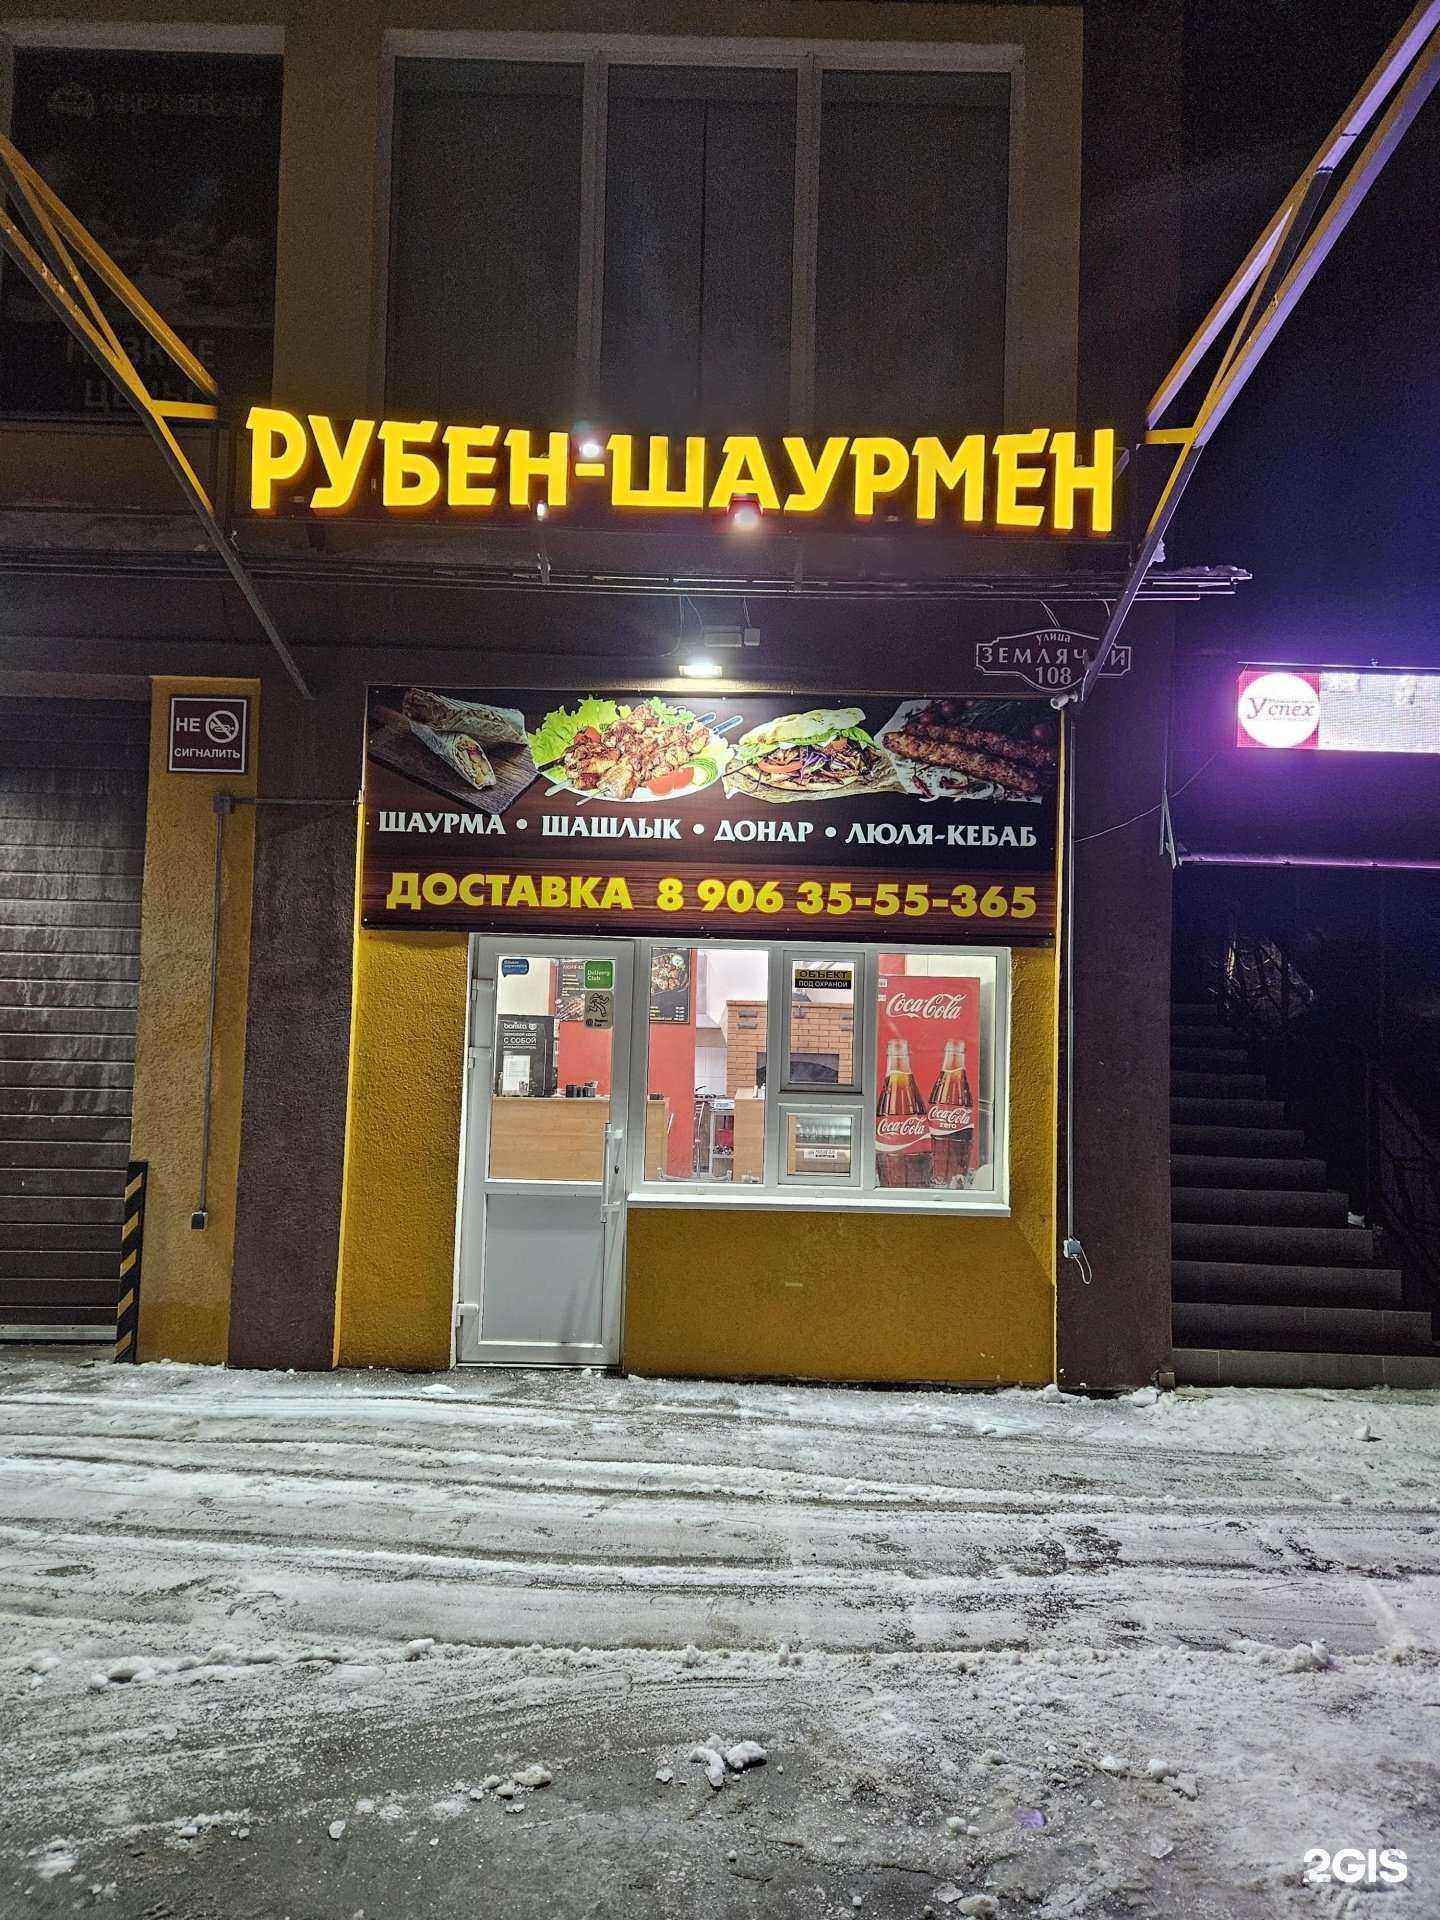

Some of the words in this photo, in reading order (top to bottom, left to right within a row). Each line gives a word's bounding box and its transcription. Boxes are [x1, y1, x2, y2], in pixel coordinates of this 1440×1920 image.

[246, 406, 1114, 532] РУБЕН-ШАУРМЕН
[1036, 634, 1071, 645] улица
[982, 647, 1125, 666] ЗЕМЛЯЧИ
[1035, 667, 1072, 685] 108
[1247, 697, 1315, 719] Успех
[175, 717, 201, 732] НЕ
[174, 747, 241, 759] СИГНАЛИТЬ
[378, 811, 507, 835] ШАУРМА
[541, 815, 682, 840] ШАШЛЫК
[713, 820, 814, 842] ДОНАР
[845, 823, 1037, 847] ЛЮЛЯ-КЕБАБ
[386, 872, 634, 911] ДОСТАВКА
[656, 878, 685, 912] 8
[697, 879, 784, 913] 906
[796, 882, 1037, 918] 35-55-365
[800, 970, 848, 979] ОБЪЕКТ
[886, 993, 967, 1019] Coca-Cola
